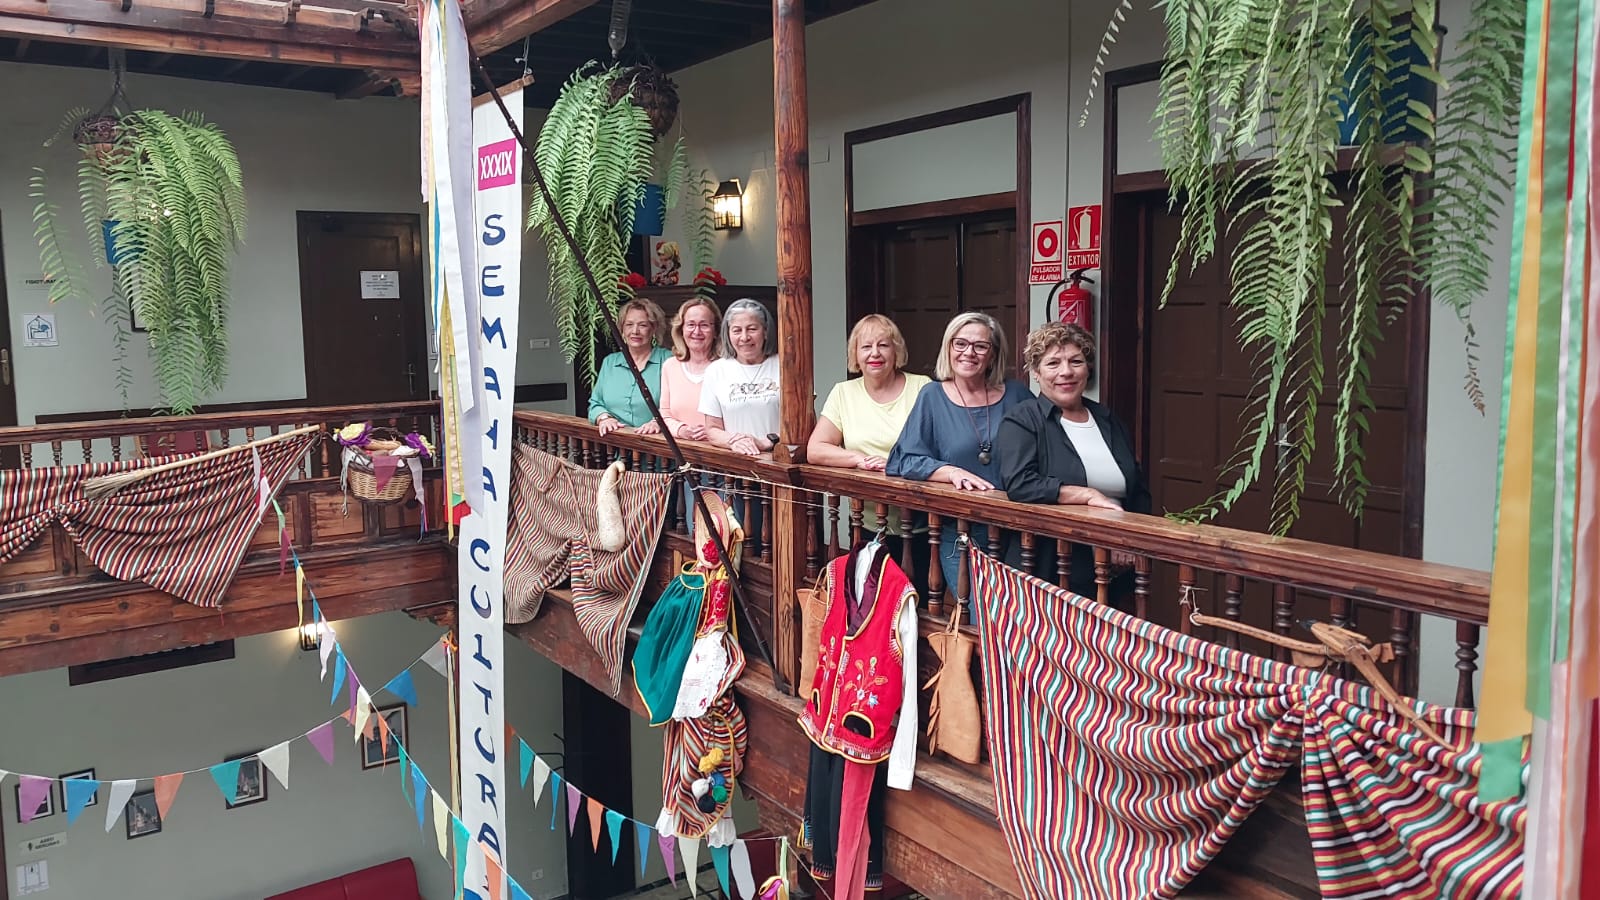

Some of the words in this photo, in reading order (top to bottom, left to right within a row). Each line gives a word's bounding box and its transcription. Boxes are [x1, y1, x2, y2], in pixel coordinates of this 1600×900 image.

[480, 150, 513, 181] XXXIX
[1032, 265, 1061, 274] PULSADOR
[1068, 253, 1099, 266] EXTINTOR
[470, 538, 503, 867] CULTURA
